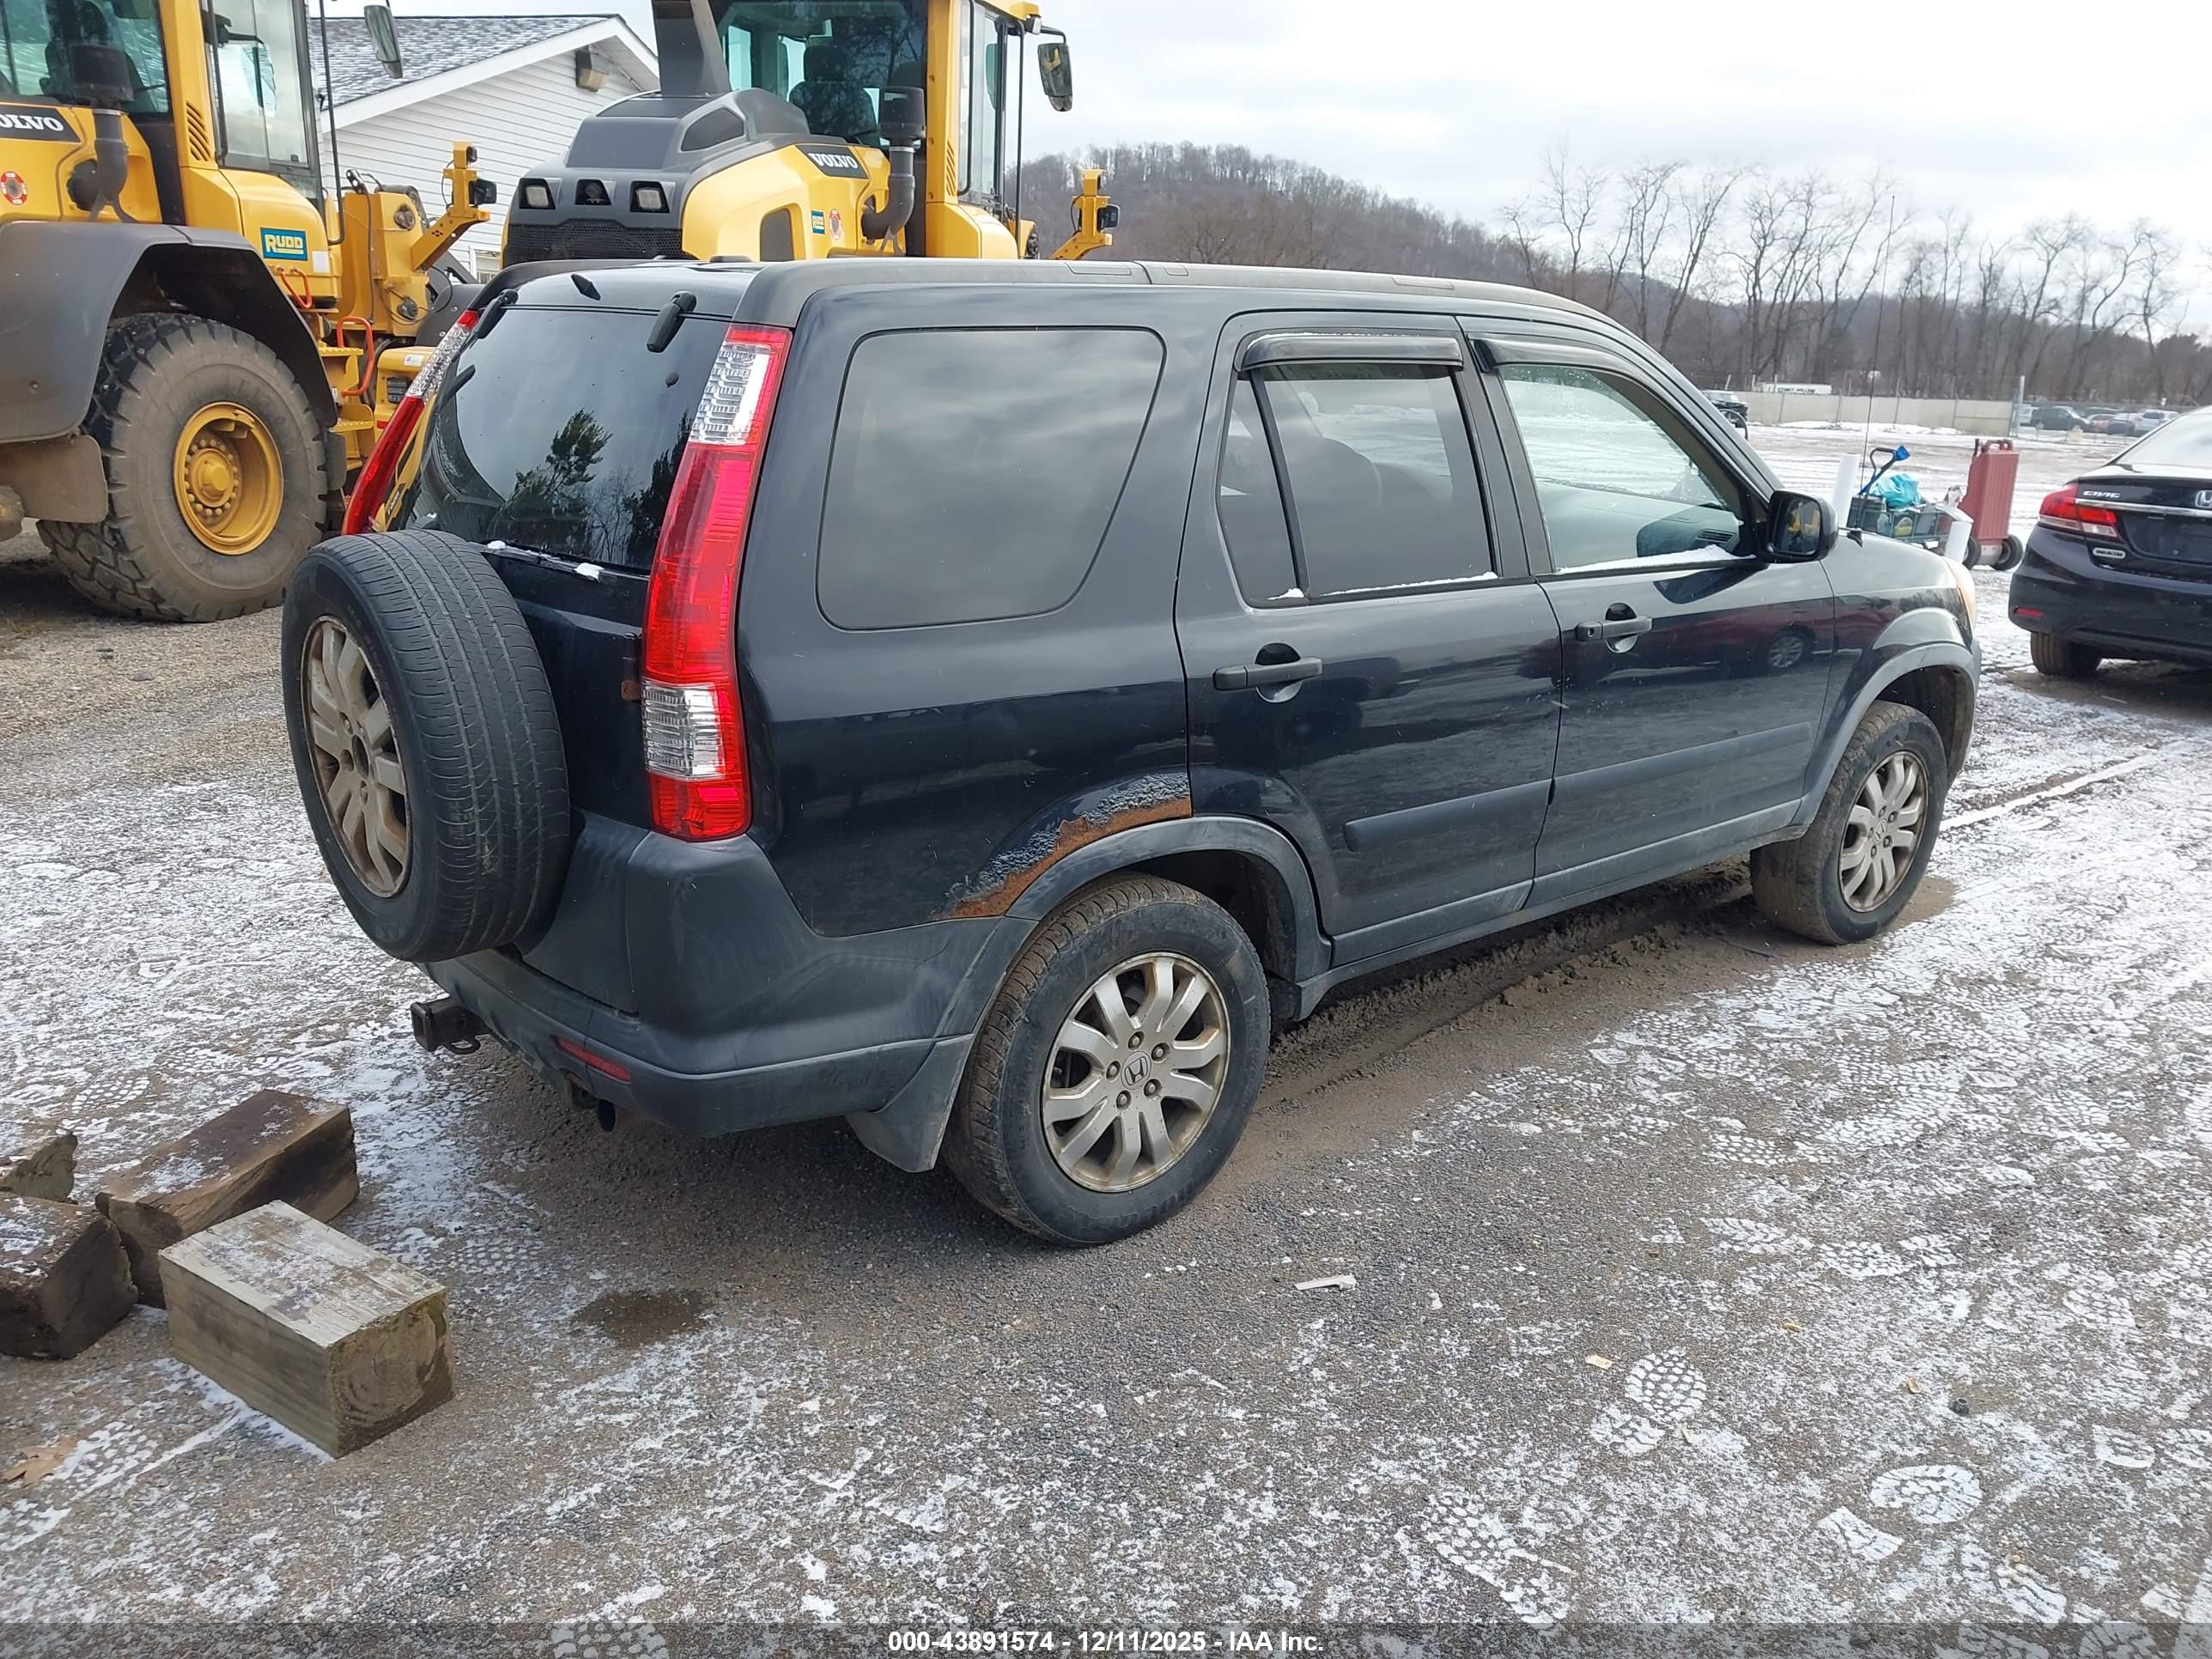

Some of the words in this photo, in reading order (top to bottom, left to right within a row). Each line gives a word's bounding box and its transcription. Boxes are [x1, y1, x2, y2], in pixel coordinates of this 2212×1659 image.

[0, 114, 64, 131] OLVO
[807, 153, 859, 169] VOLVO
[264, 234, 304, 255] RUDD
